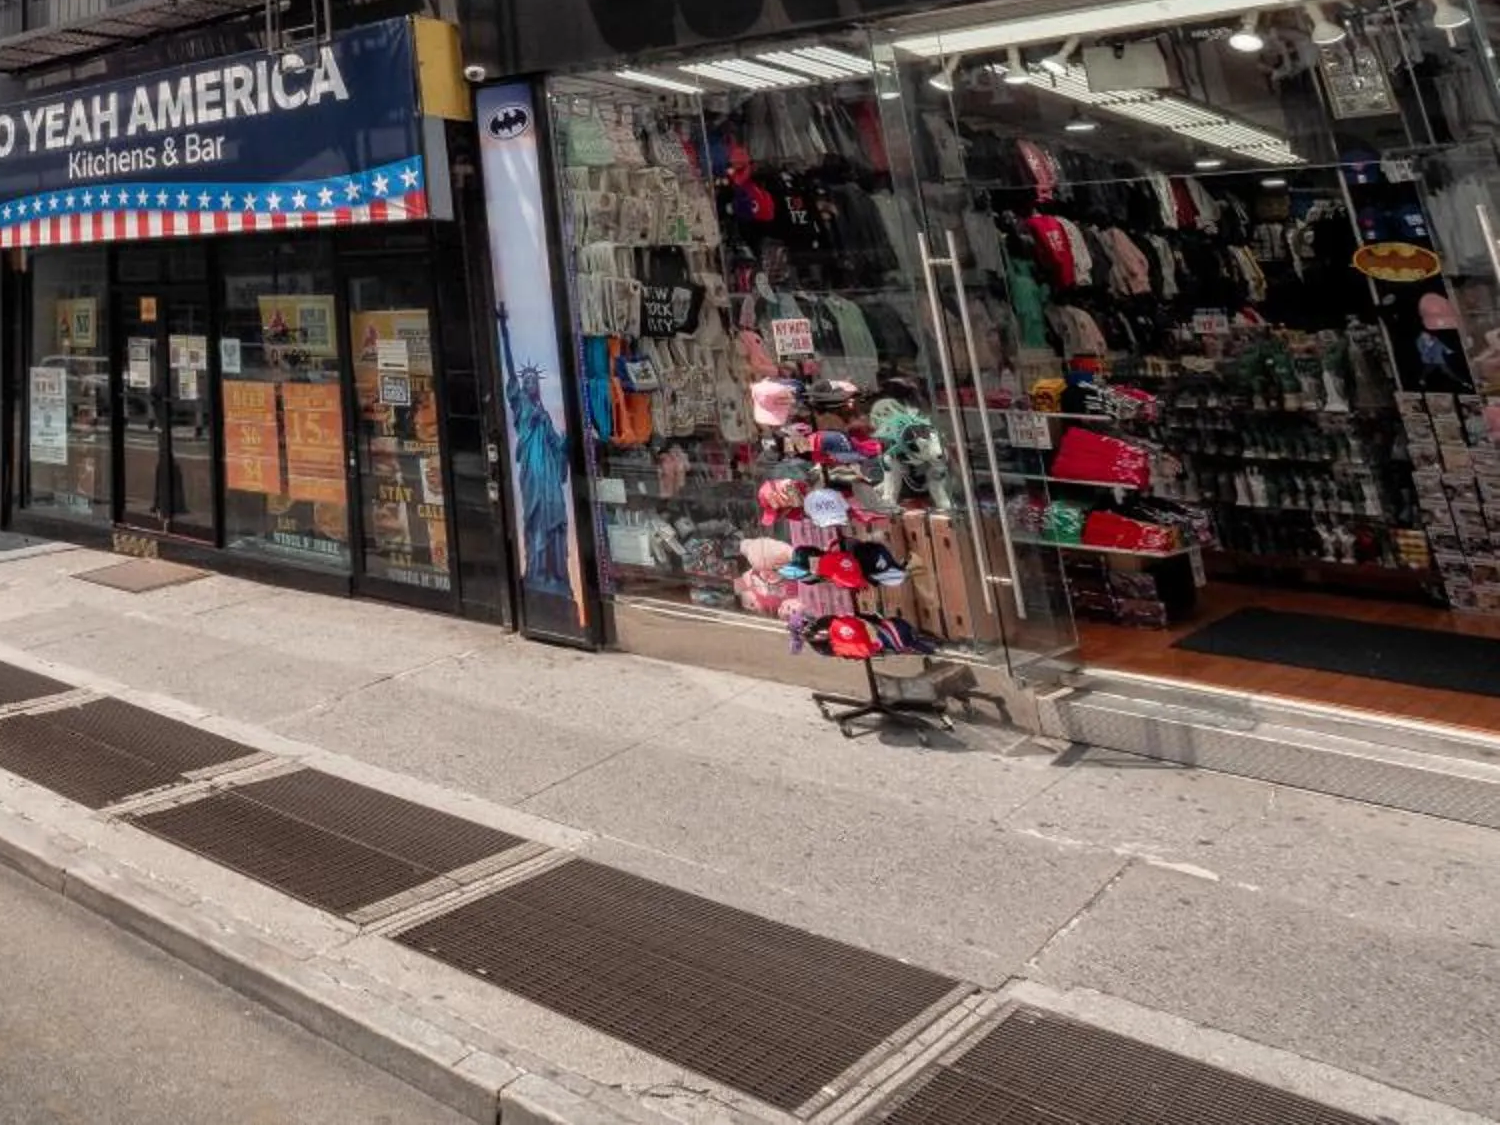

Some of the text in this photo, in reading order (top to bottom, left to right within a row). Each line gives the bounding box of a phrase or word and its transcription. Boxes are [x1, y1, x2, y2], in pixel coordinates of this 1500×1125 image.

[22, 90, 118, 153] YEAH
[126, 45, 350, 137] AMERICA
[68, 132, 226, 180] Kitchens & Bar
